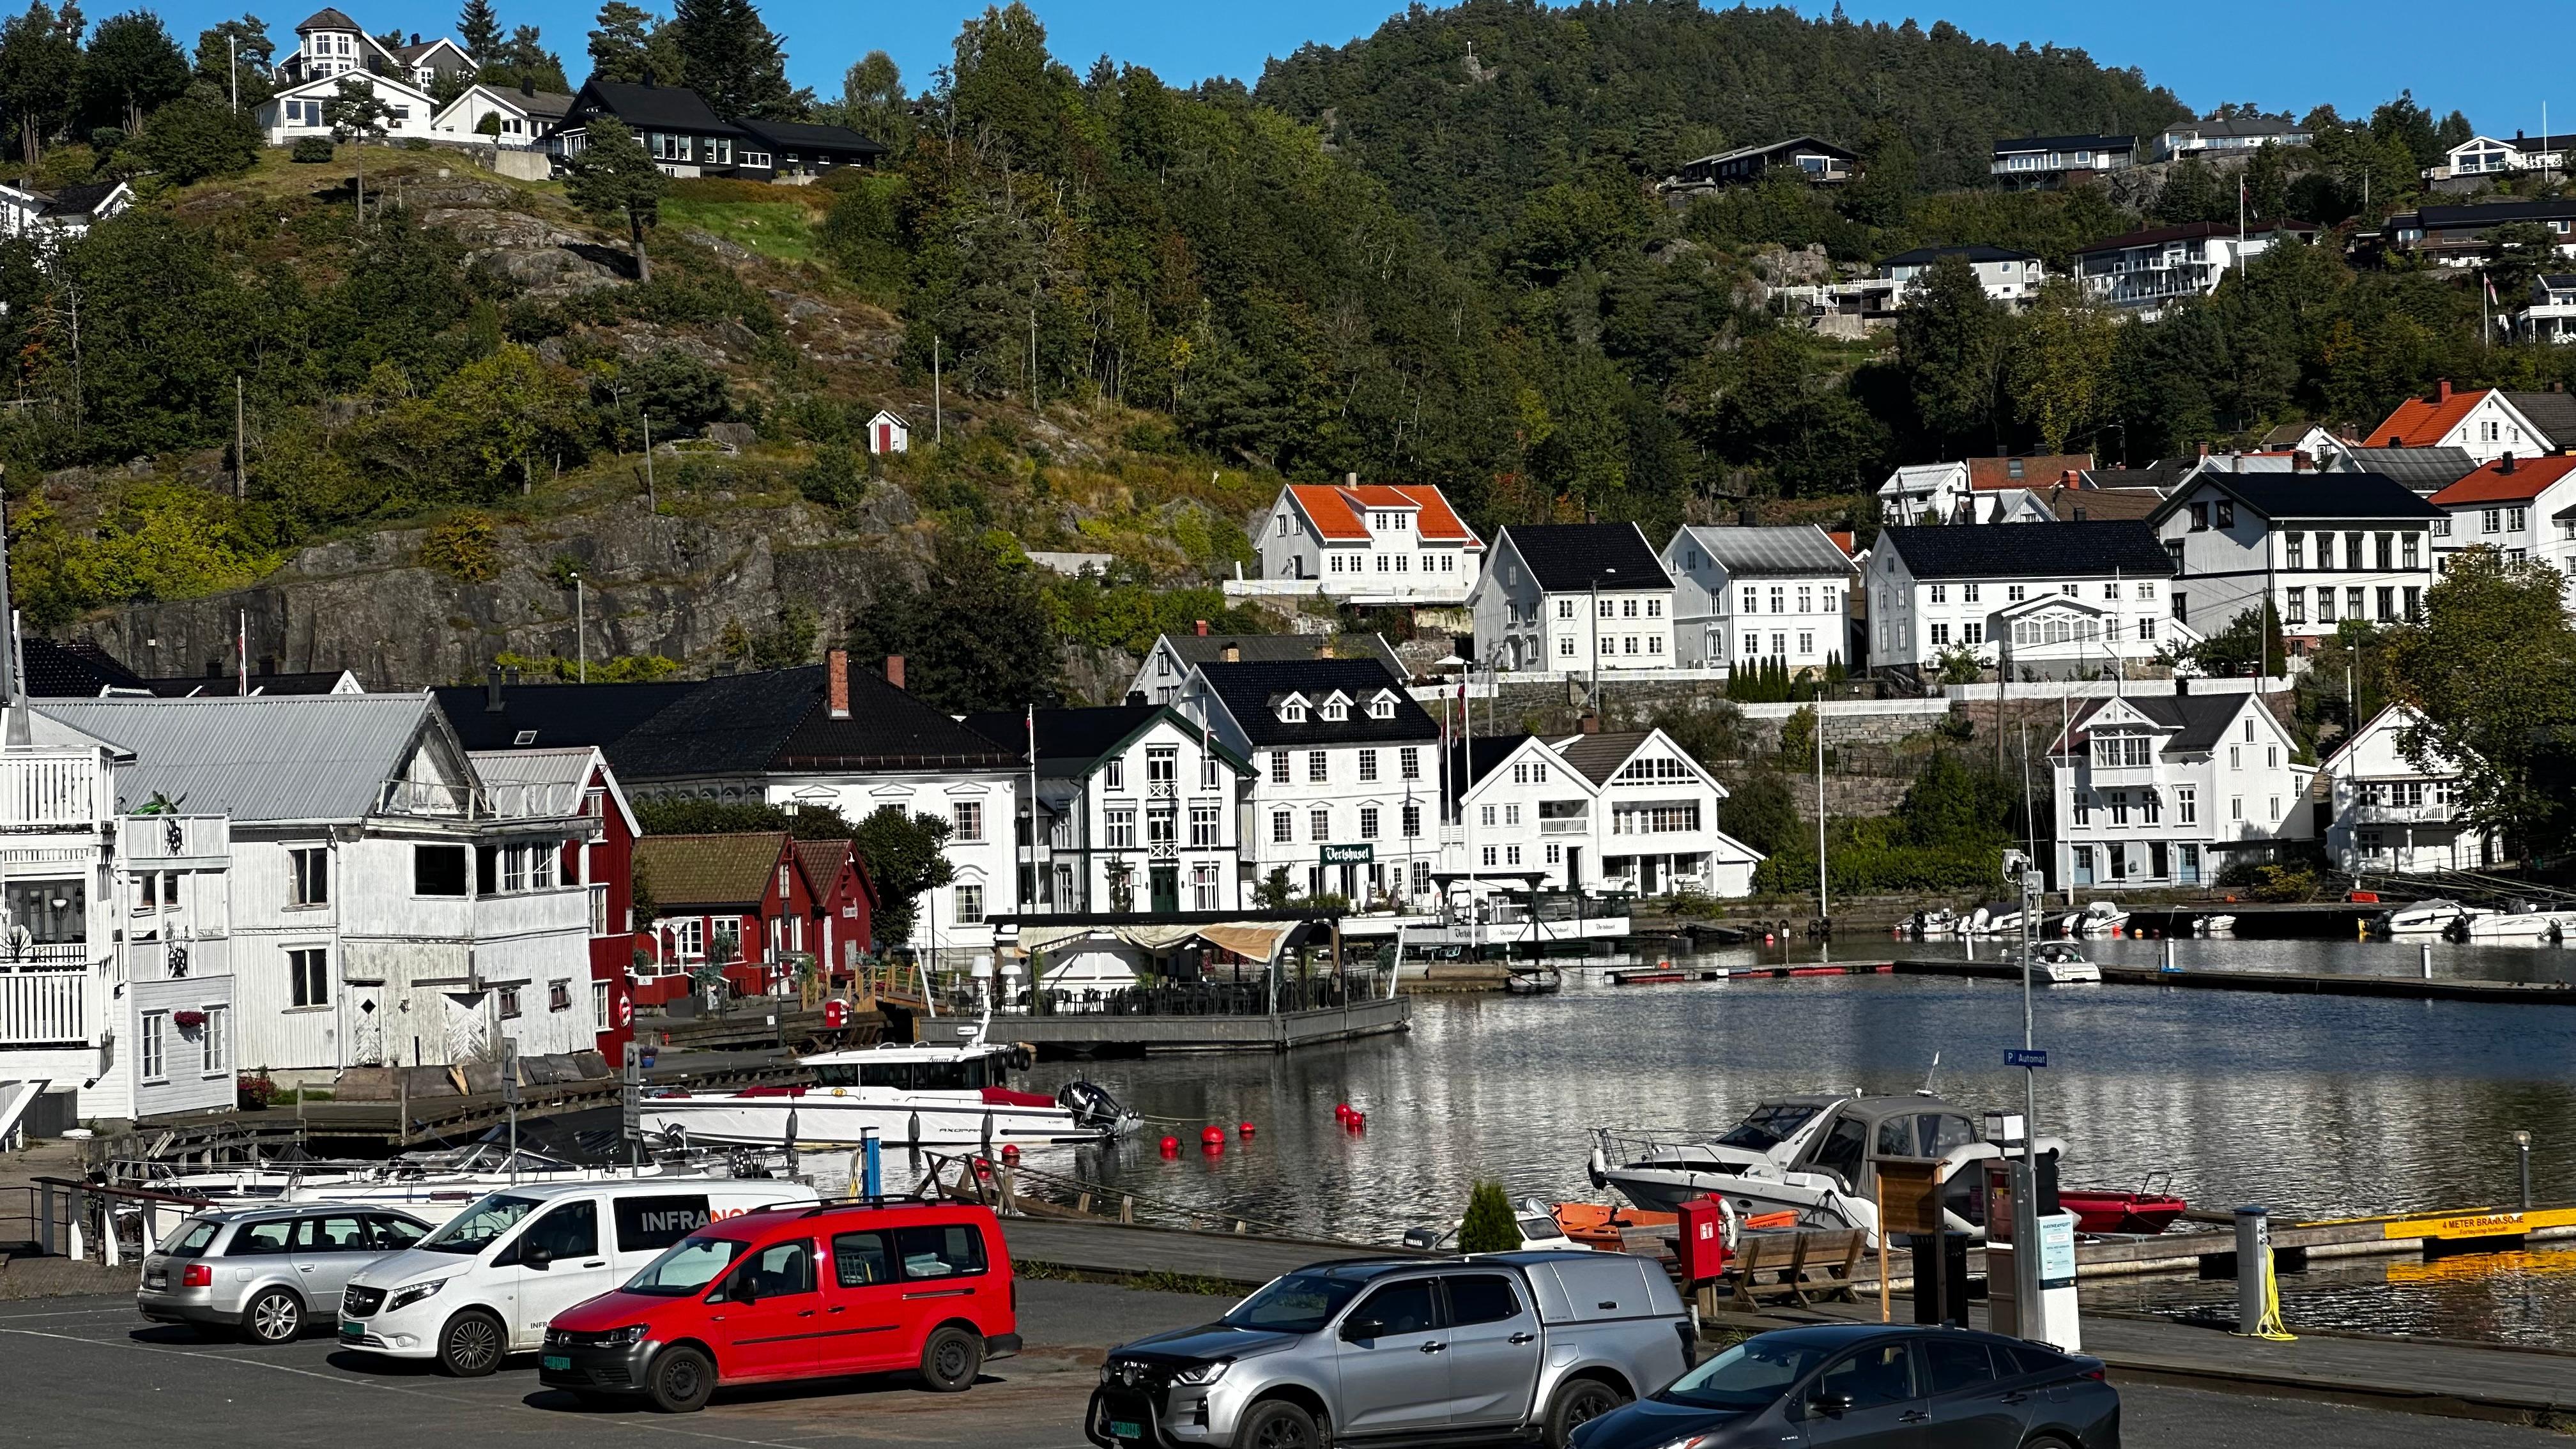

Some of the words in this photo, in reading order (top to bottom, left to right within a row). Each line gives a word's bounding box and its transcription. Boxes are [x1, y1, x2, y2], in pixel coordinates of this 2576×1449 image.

[506, 1044, 513, 1073] P
[627, 1048, 635, 1078] P
[2008, 1052, 2014, 1062] P
[2018, 1053, 2046, 1064] Automat
[2448, 1219, 2475, 1229] METER
